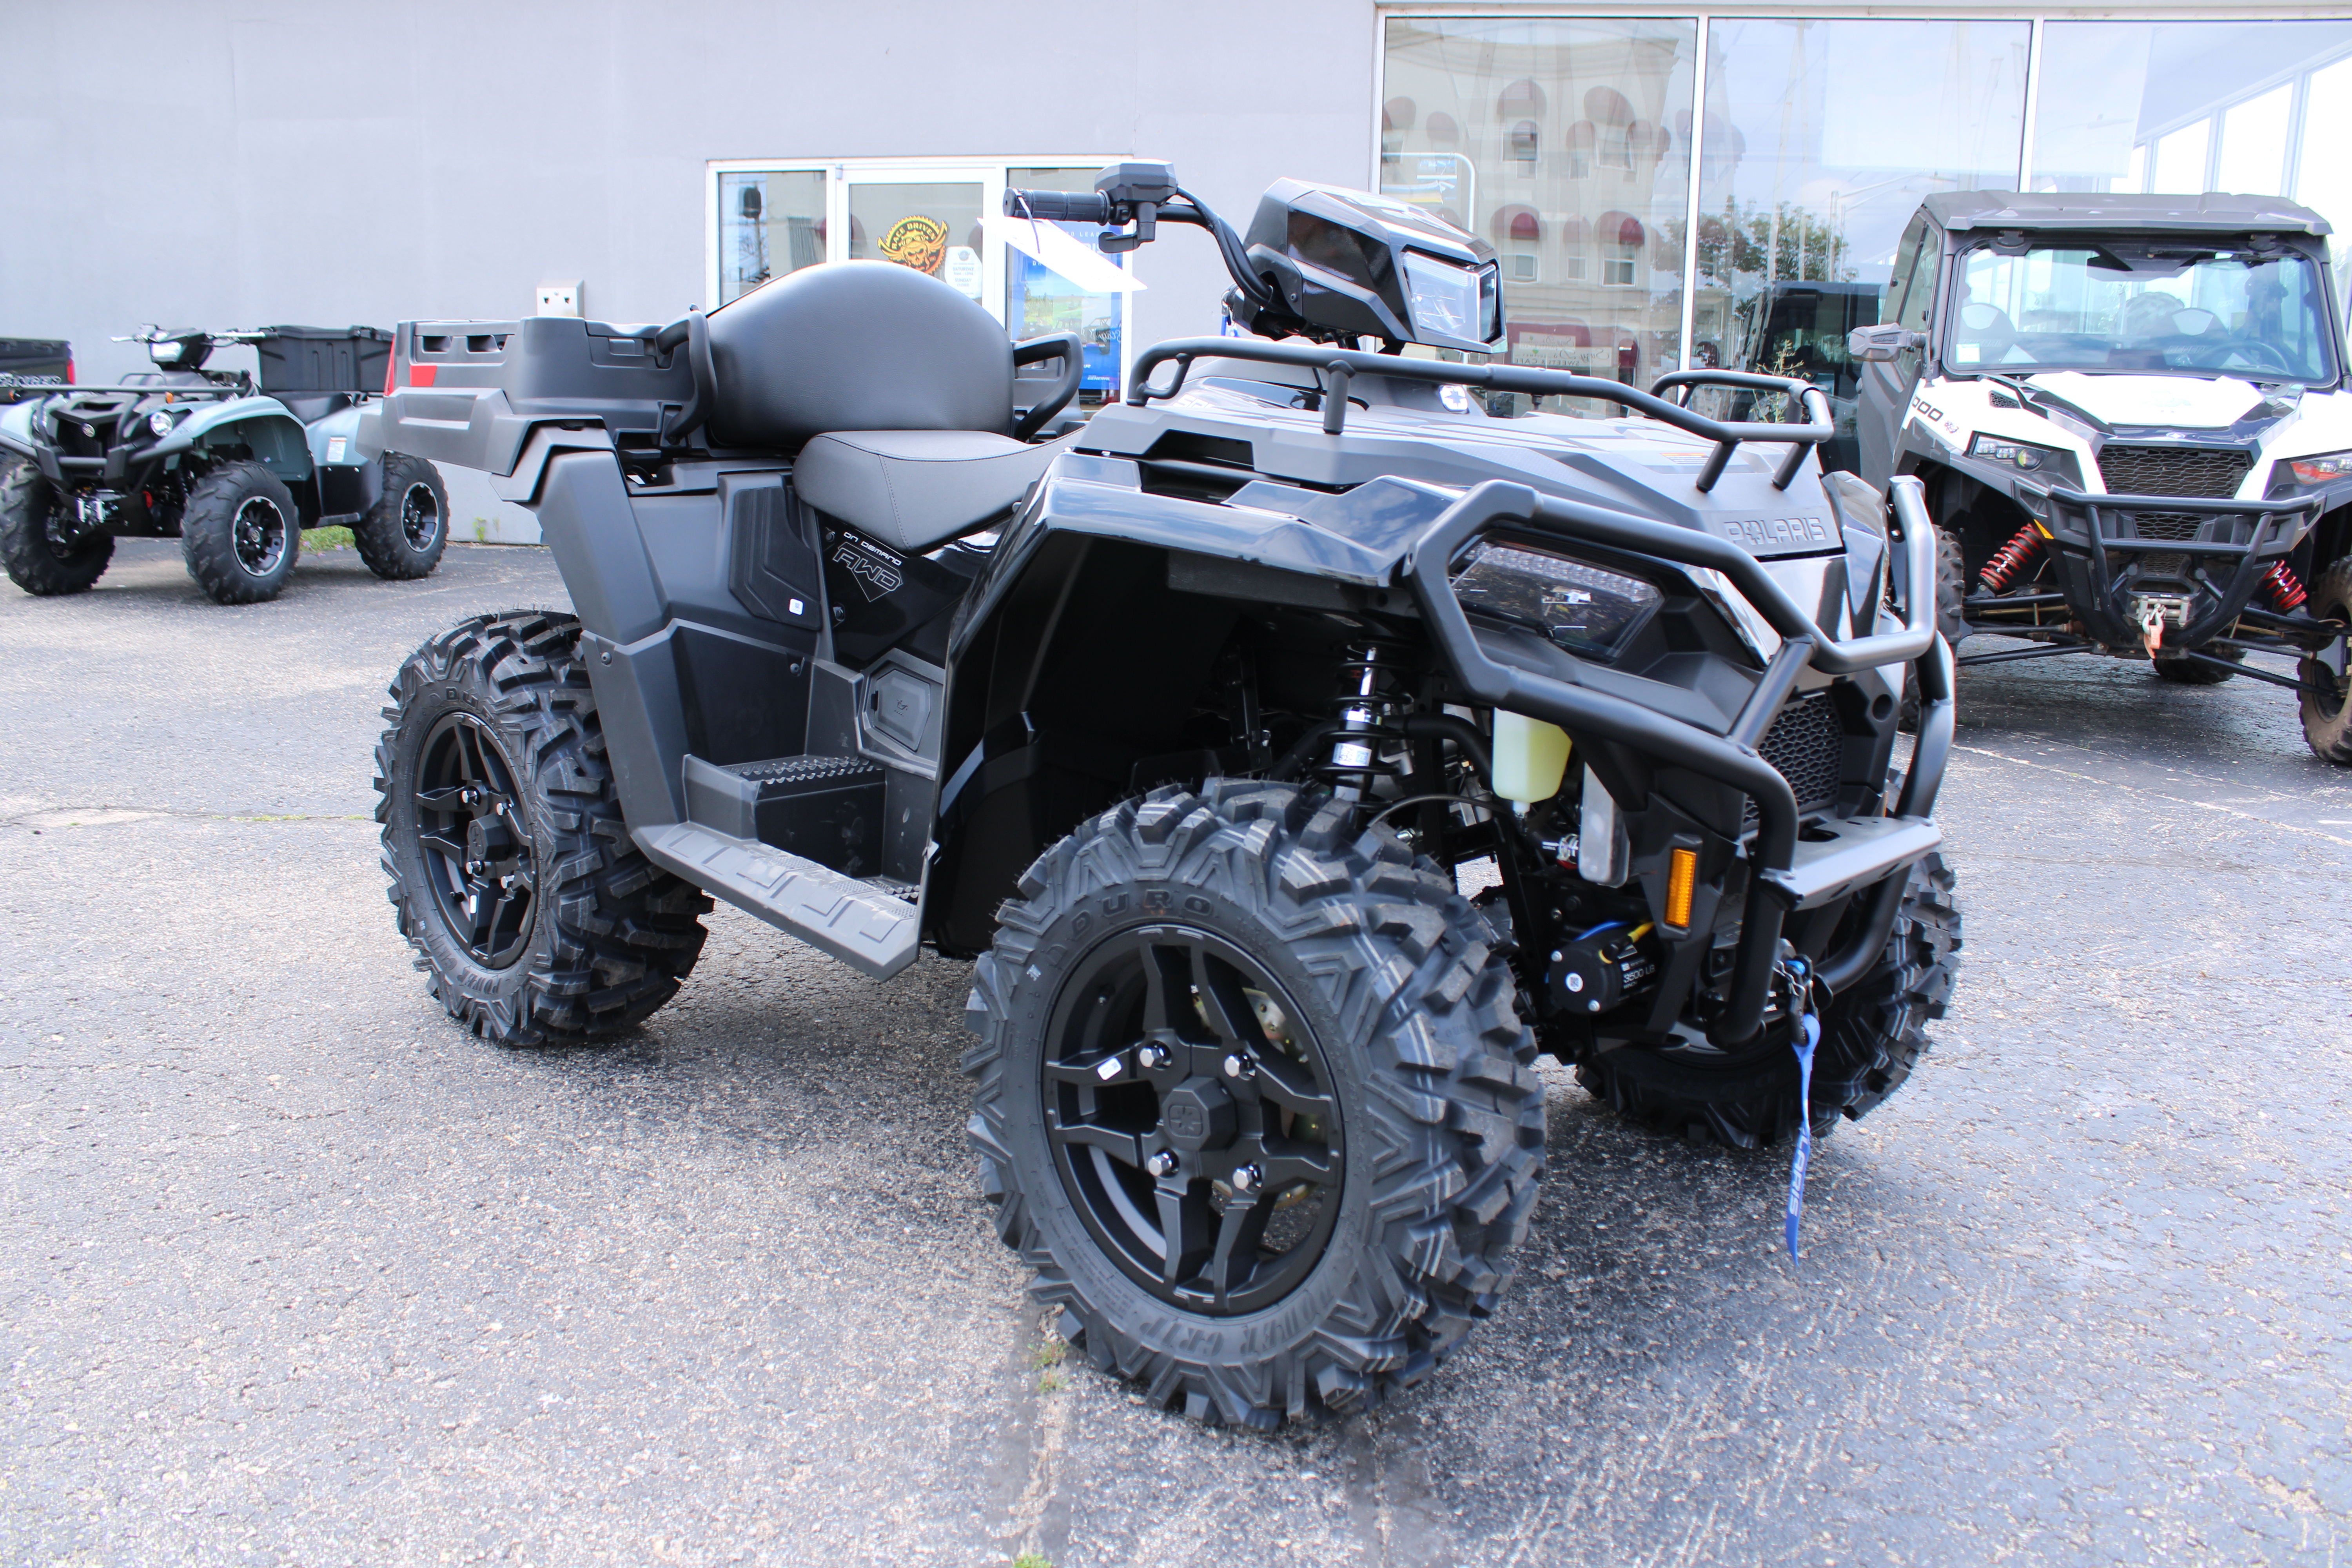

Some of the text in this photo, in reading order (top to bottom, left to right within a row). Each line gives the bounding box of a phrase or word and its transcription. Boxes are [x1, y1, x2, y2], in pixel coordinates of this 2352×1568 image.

[891, 223, 936, 249] RACE DRIVEN
[1724, 517, 1826, 545] POLARIS
[860, 541, 902, 566] DEMAND
[832, 547, 900, 592] AWD
[1071, 888, 1212, 937] DURO
[1623, 969, 1644, 983] 3500
[1789, 1127, 1809, 1217] LARIS
